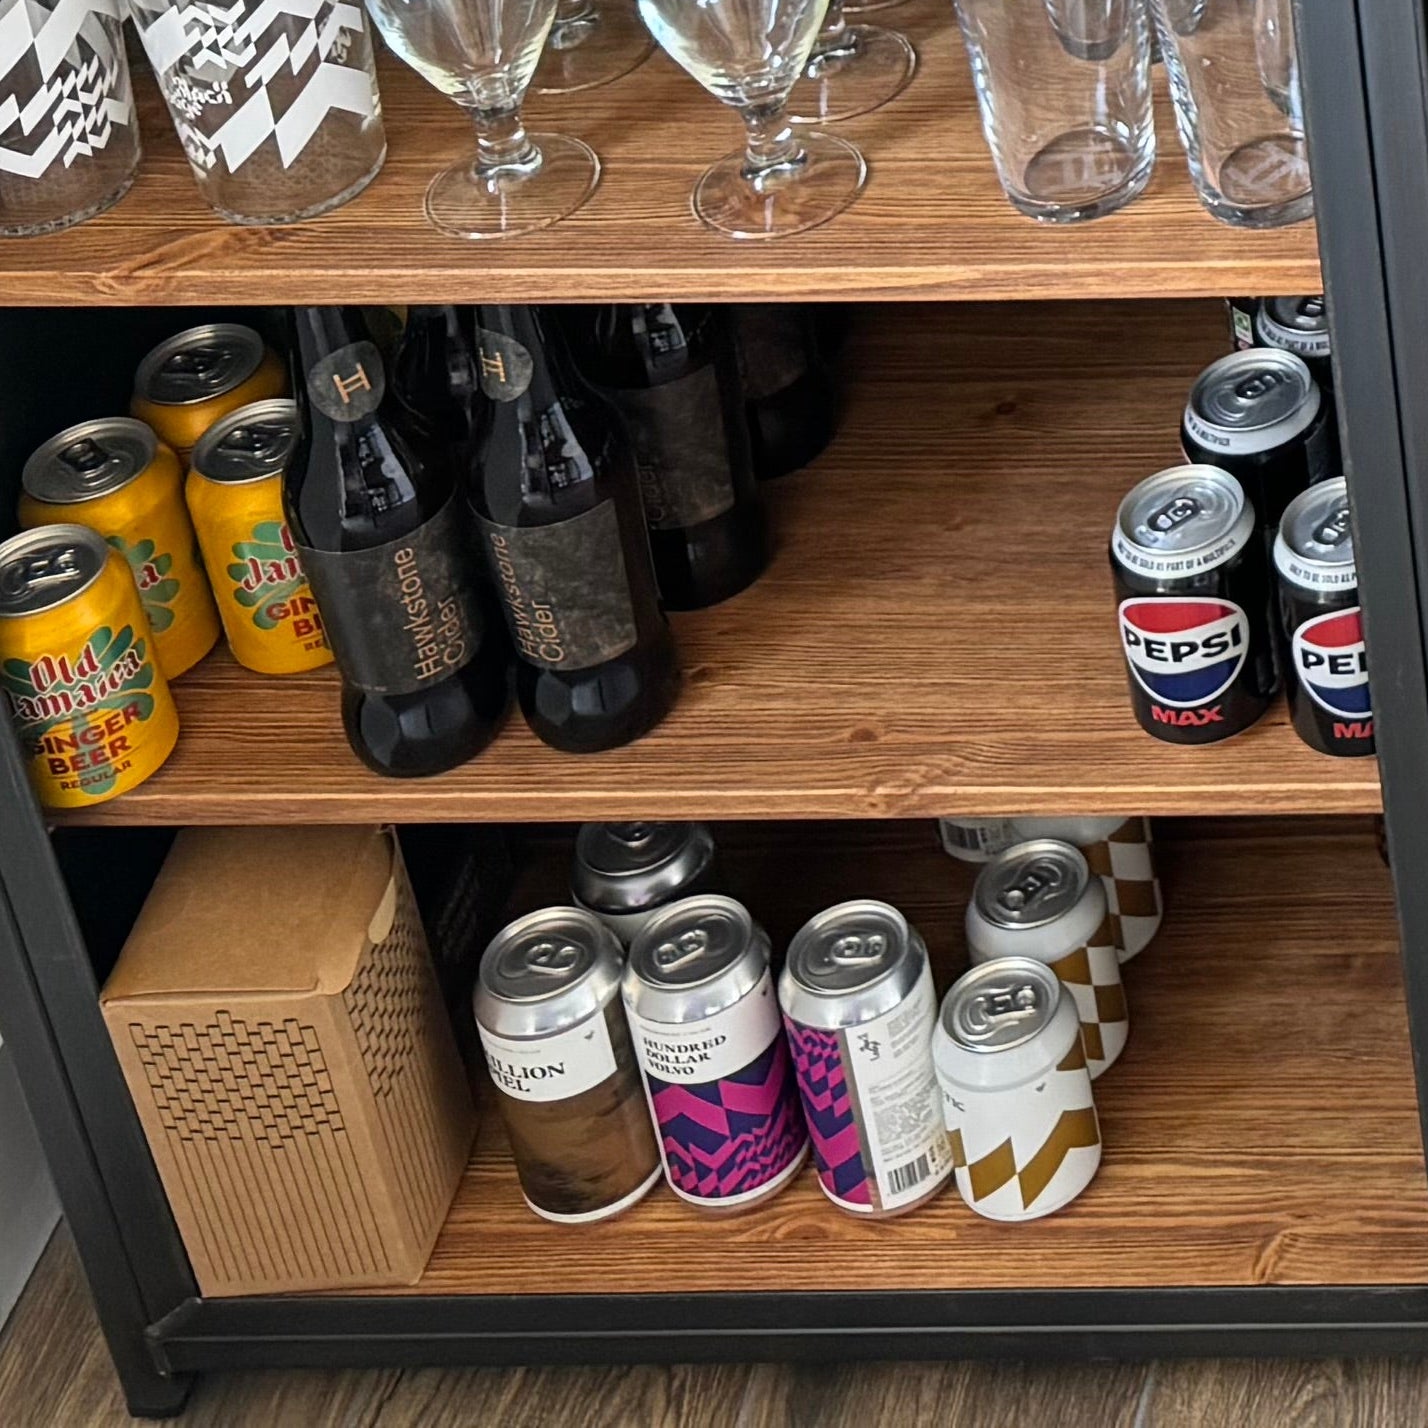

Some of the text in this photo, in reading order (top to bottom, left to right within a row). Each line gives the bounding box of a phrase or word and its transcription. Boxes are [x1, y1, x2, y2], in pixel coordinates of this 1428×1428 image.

[393, 546, 443, 681] Hawkstone
[489, 532, 540, 659] Hawkstone
[437, 595, 466, 665] Cider
[530, 599, 566, 663] Cider
[1125, 623, 1243, 664] PEPSI
[29, 642, 101, 695] Old
[1151, 704, 1225, 728] MAX
[49, 736, 133, 778] BEER
[60, 759, 133, 792] REGULAR
[643, 1034, 728, 1055] HUNDRED
[646, 1049, 712, 1066] DOLLAR
[649, 1060, 696, 1076] VOLVO
